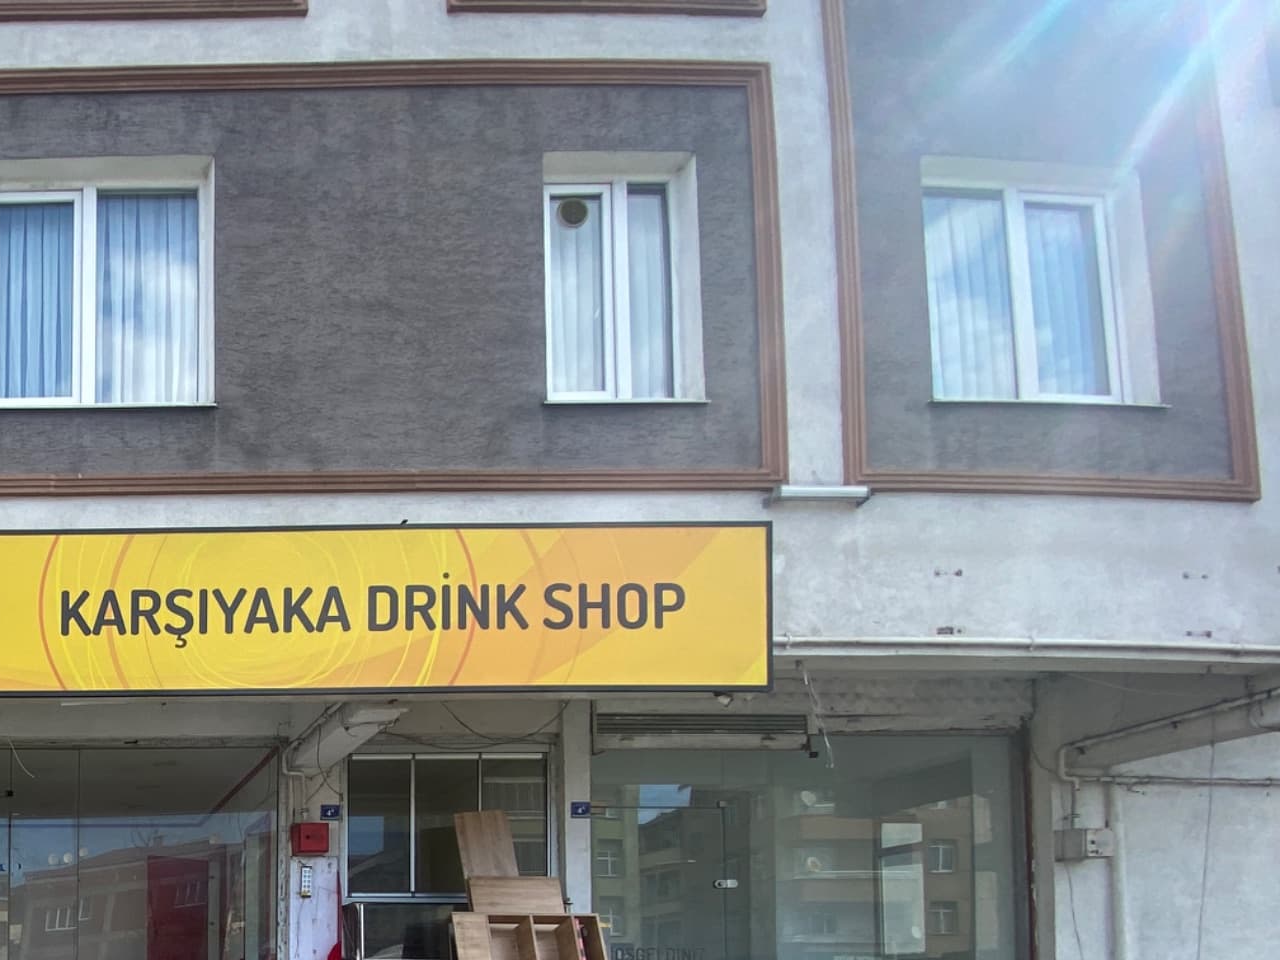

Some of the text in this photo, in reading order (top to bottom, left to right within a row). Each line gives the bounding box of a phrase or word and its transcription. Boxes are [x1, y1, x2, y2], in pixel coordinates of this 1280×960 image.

[60, 572, 686, 648] KARŞIYAKA DRİNK SHOP
